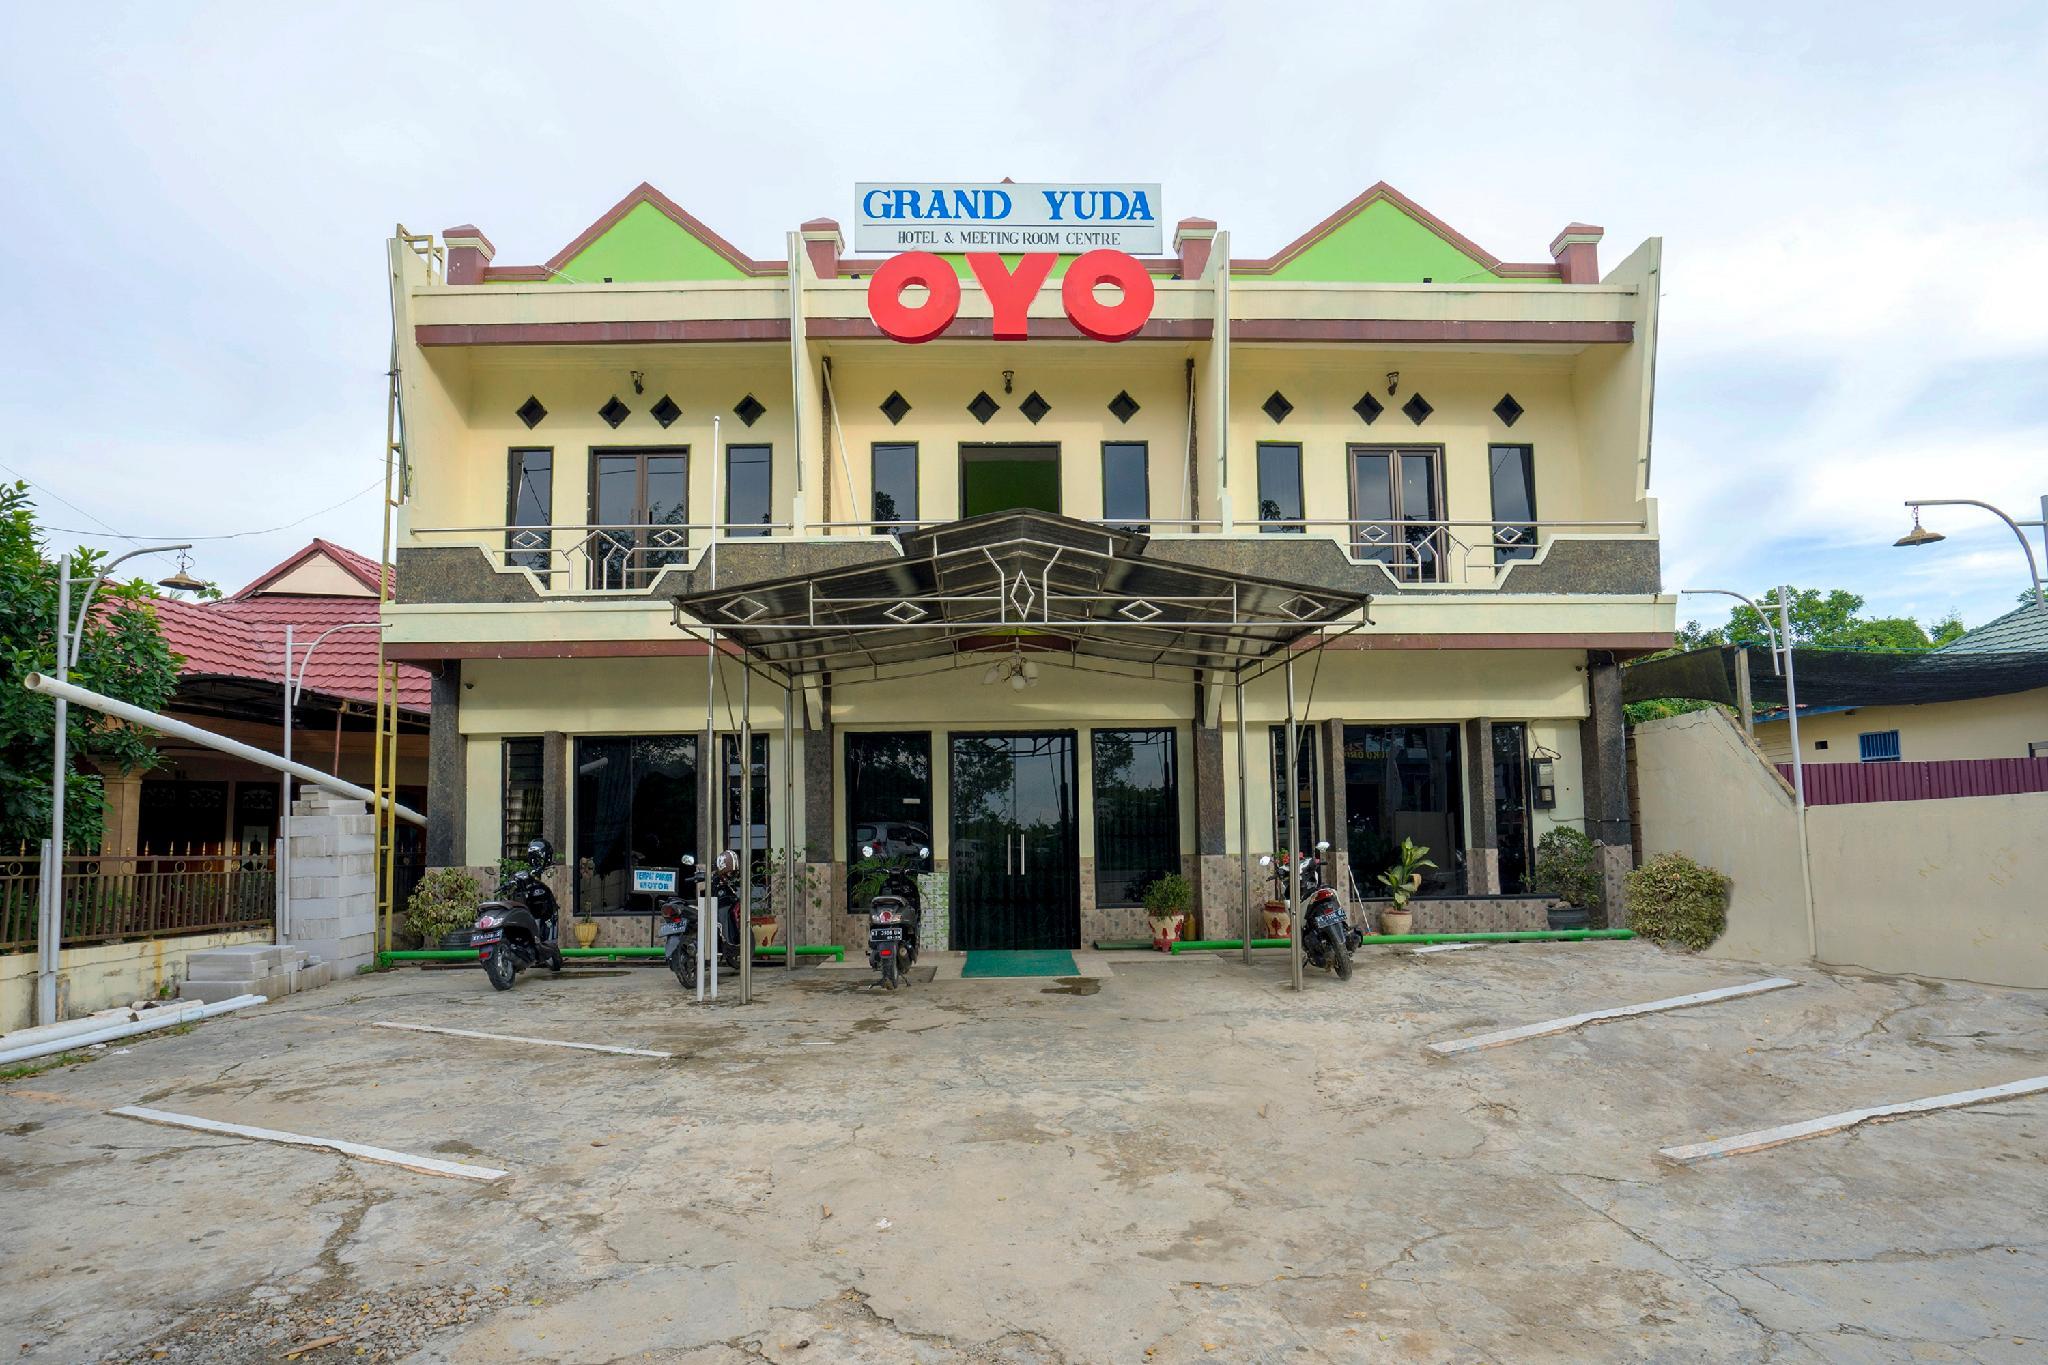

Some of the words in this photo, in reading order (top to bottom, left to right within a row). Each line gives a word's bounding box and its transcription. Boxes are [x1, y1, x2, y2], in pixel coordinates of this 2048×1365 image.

[862, 190, 1012, 219] GRAND
[1042, 191, 1155, 221] YUDA
[897, 231, 939, 244] HOTEL
[943, 232, 954, 244] &
[960, 231, 1019, 245] MEETING
[1022, 232, 1060, 245] ROOM
[1065, 232, 1121, 246] CENTRE
[867, 249, 1155, 344] OYO
